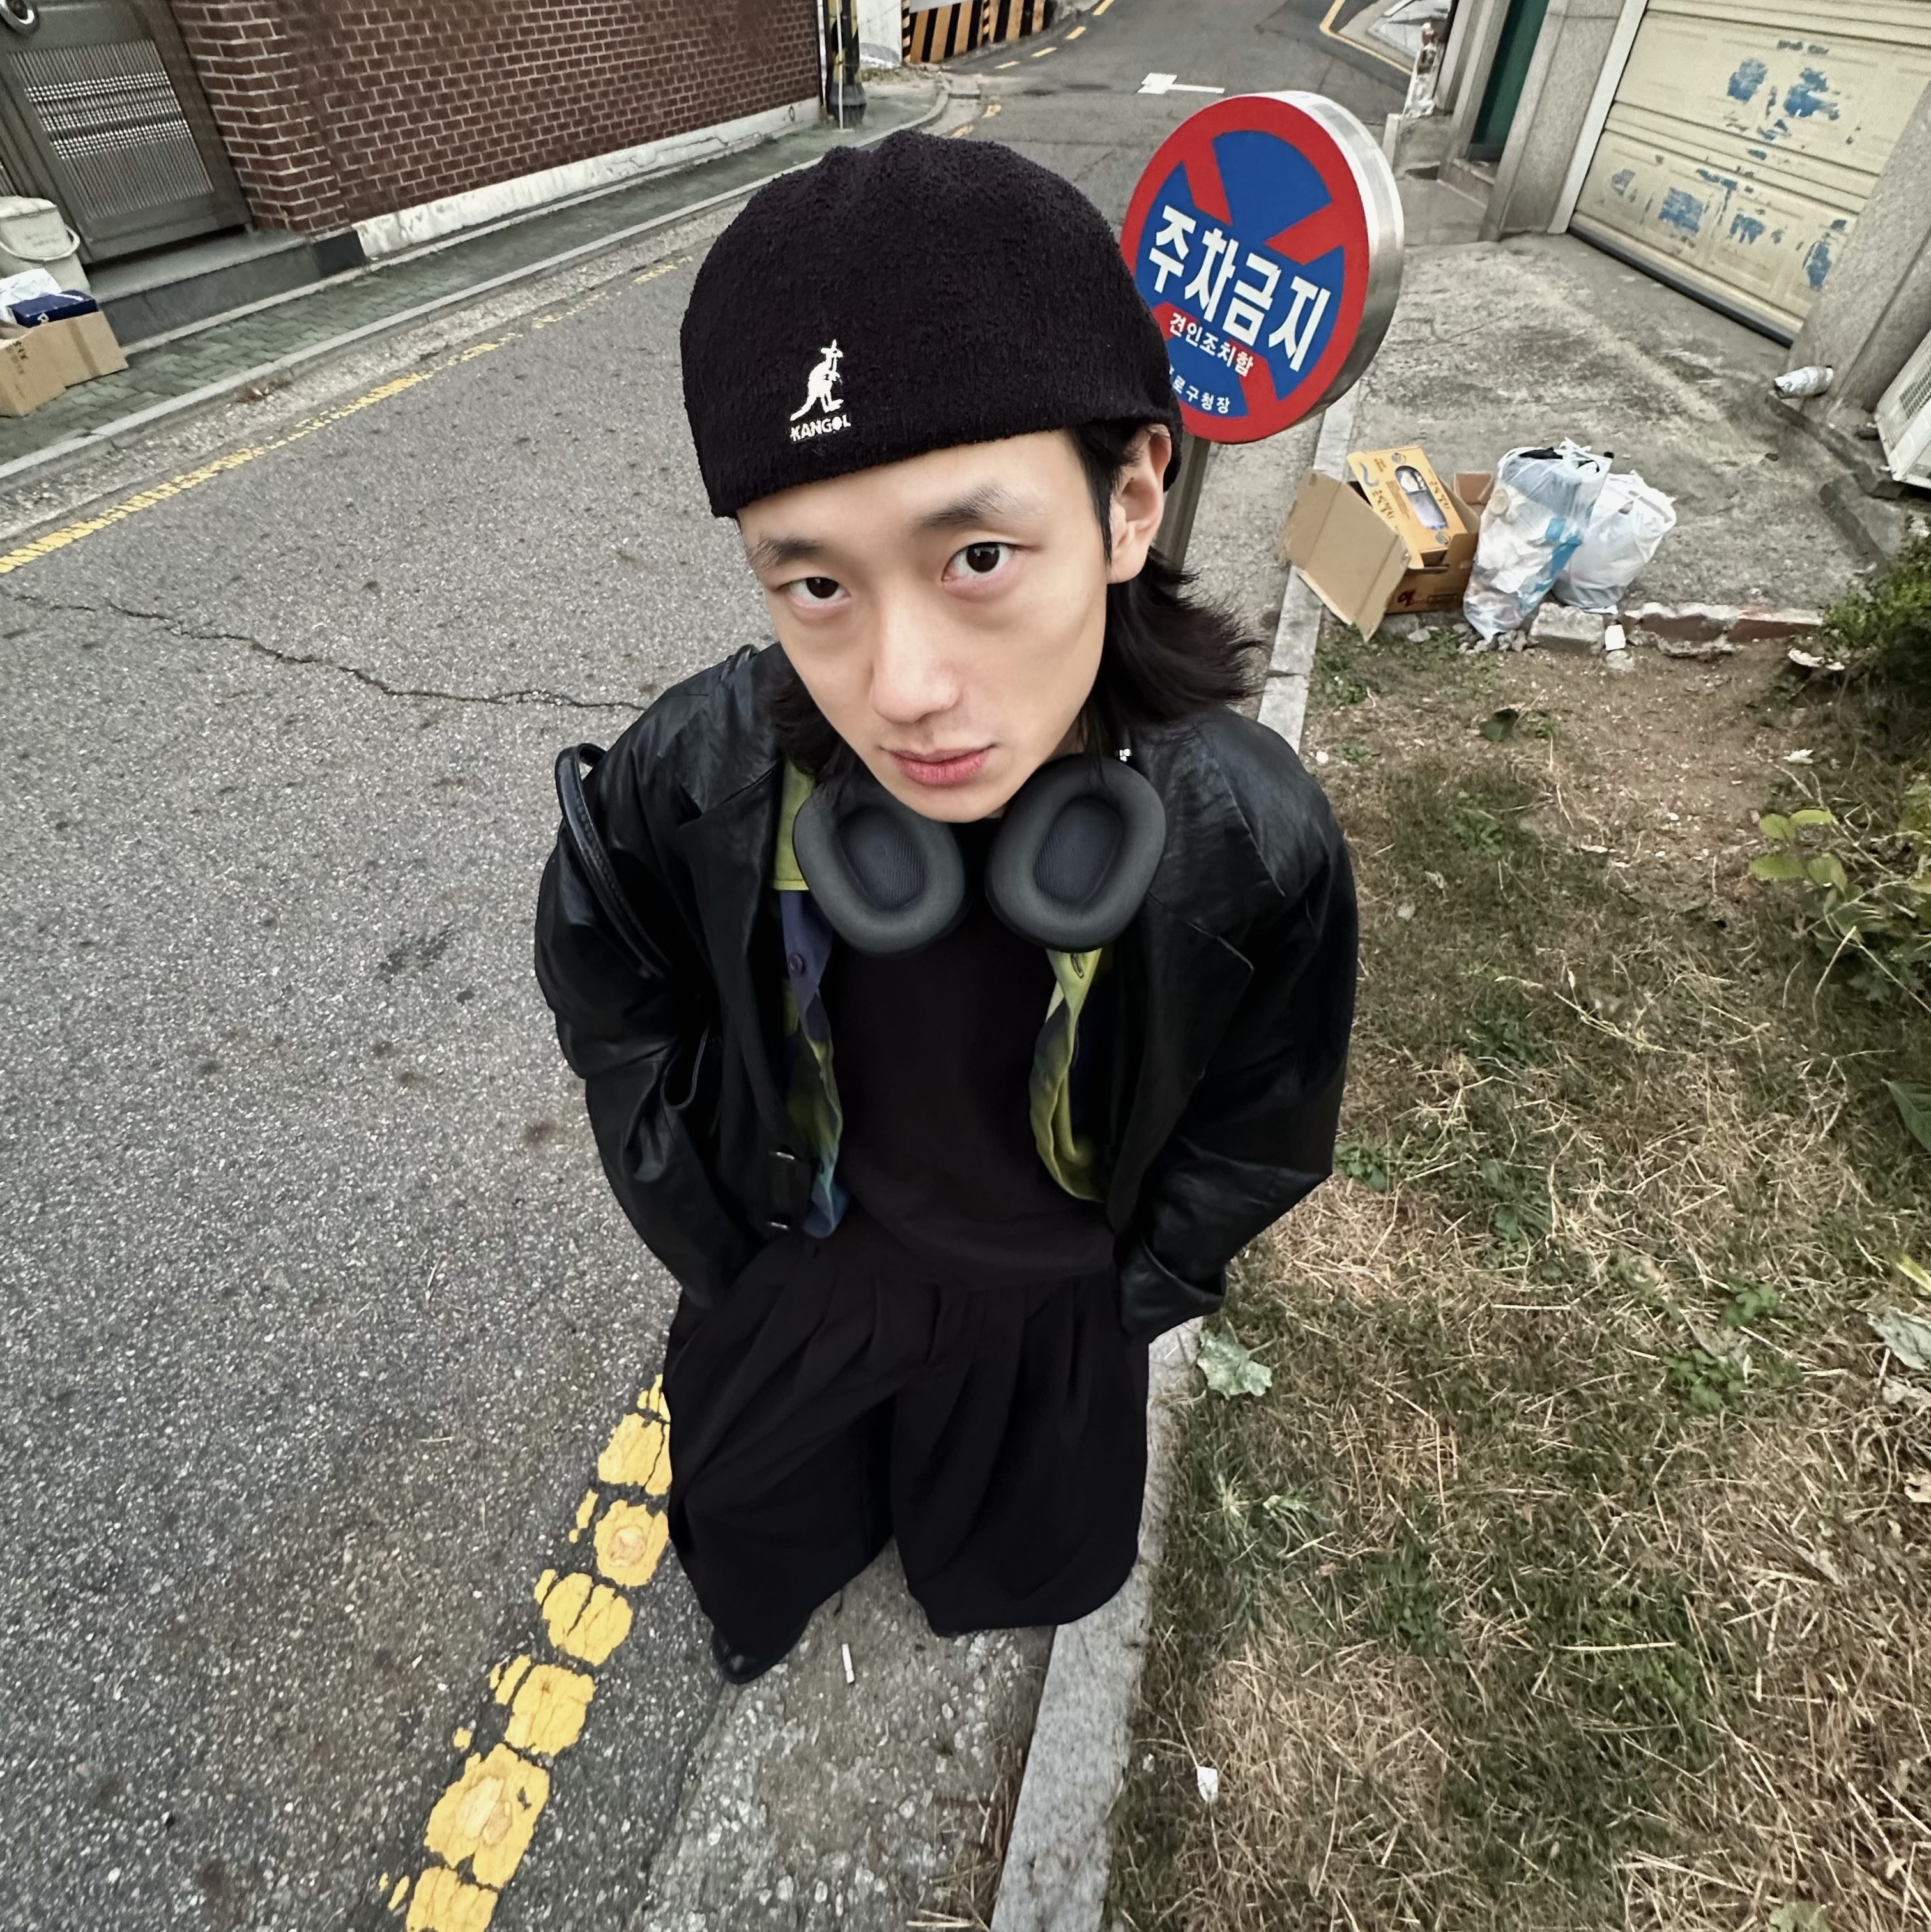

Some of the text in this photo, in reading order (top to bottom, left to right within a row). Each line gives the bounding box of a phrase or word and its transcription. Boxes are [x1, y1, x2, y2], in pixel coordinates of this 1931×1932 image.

[1149, 205, 1331, 372] 주차금지
[1170, 312, 1254, 377] 견인조치함
[1169, 365, 1230, 414] 로구청장
[790, 415, 851, 441] KANGOL
